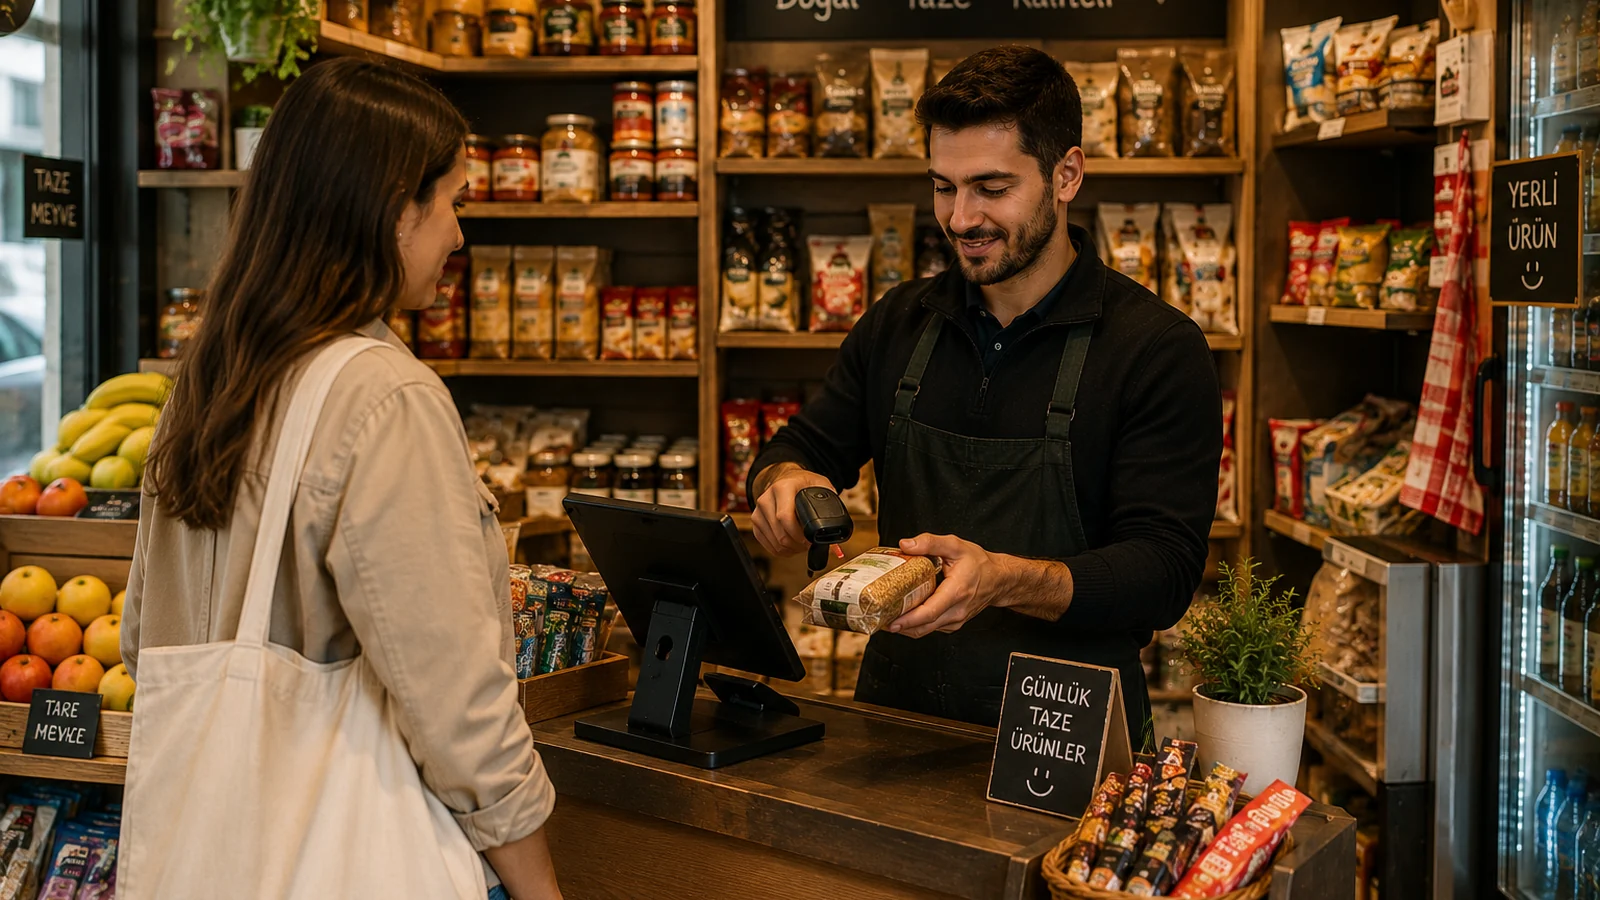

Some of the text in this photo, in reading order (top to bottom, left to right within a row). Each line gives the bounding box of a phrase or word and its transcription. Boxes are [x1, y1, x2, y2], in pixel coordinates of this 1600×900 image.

[33, 168, 71, 195] TAZE
[1508, 171, 1558, 209] YERLİ
[1508, 217, 1557, 251] ÜRÜN
[1021, 674, 1091, 708] GÜNLÜK
[45, 699, 80, 718] TARE
[1029, 705, 1073, 732] TAZE
[1010, 726, 1086, 765] ÜRÜNLER
